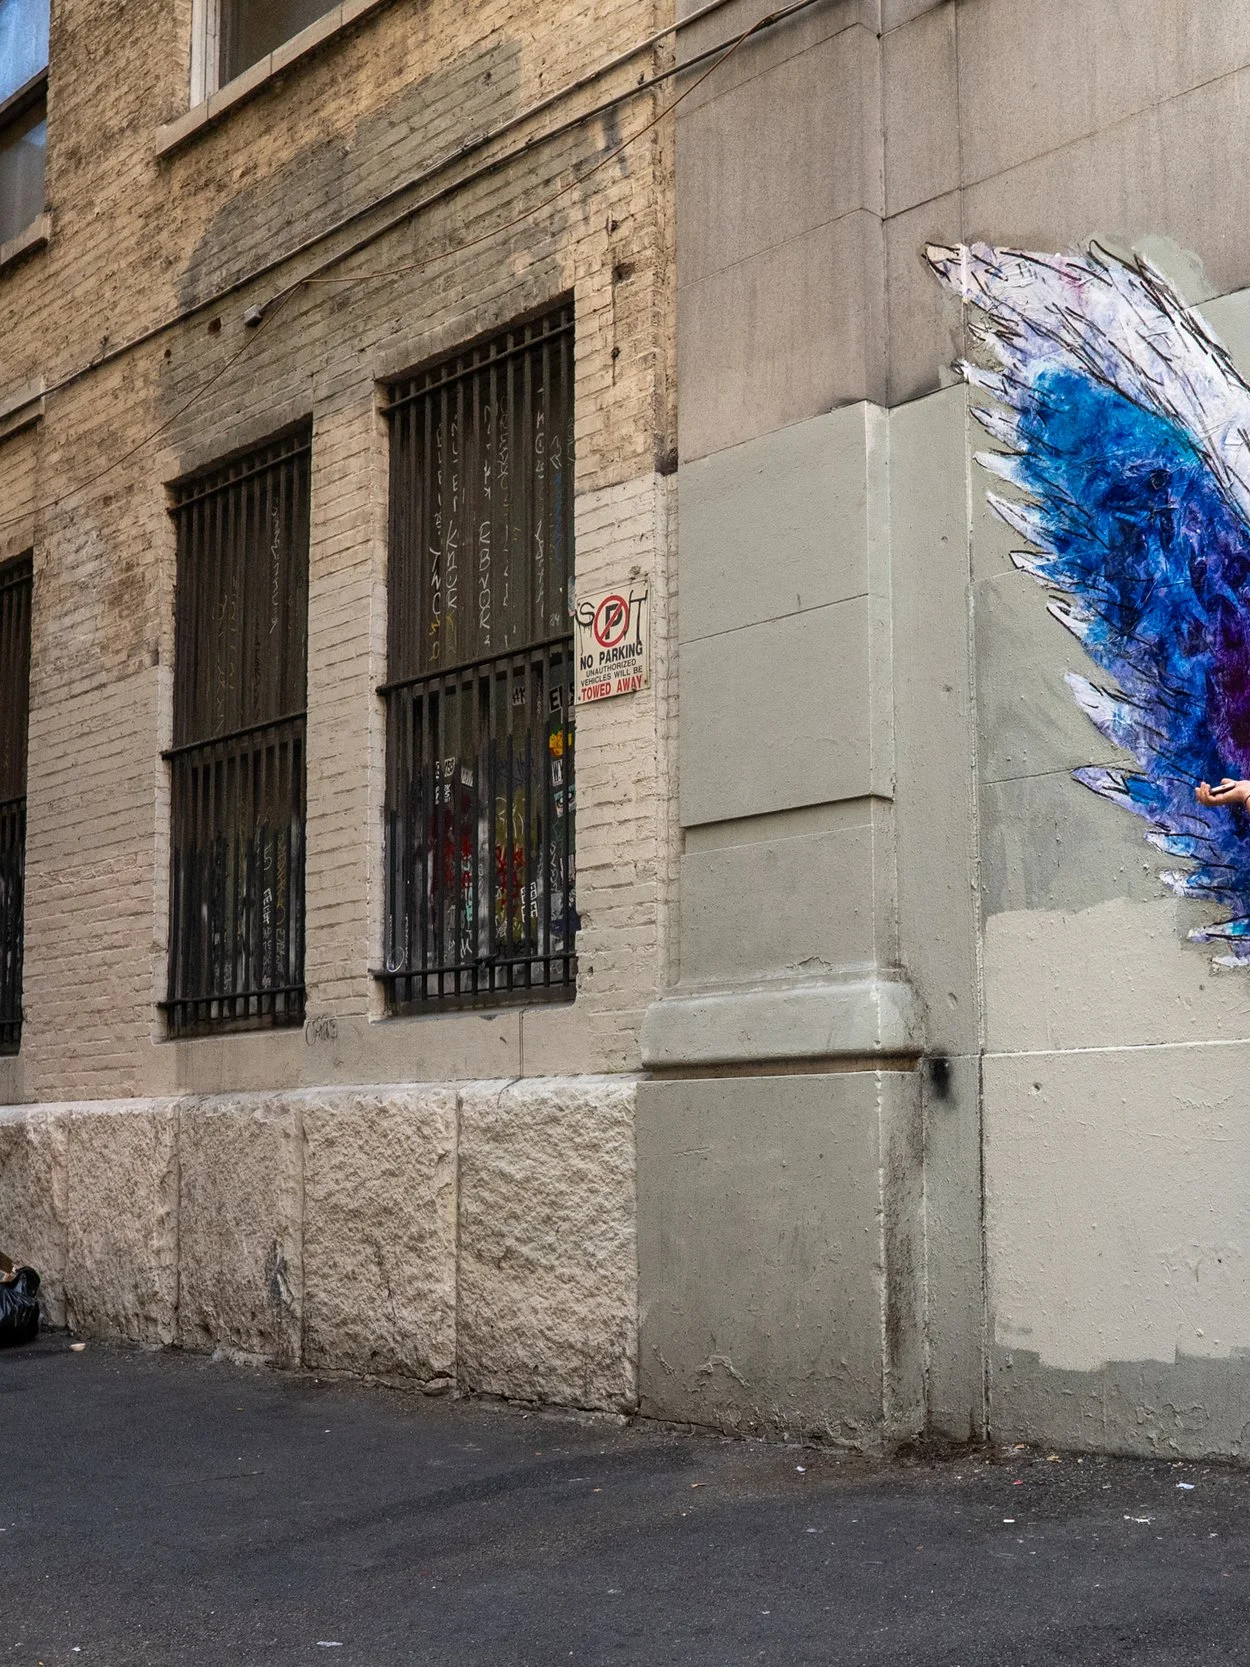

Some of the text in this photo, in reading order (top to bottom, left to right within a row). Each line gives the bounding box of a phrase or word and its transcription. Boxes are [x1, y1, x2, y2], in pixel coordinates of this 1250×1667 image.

[580, 643, 643, 671] NO PARKING
[586, 658, 637, 677] UNAUTHORIZED
[581, 665, 643, 687] VEHICLES WILL BE
[581, 682, 612, 701] TOWED
[616, 675, 643, 693] AWAY
